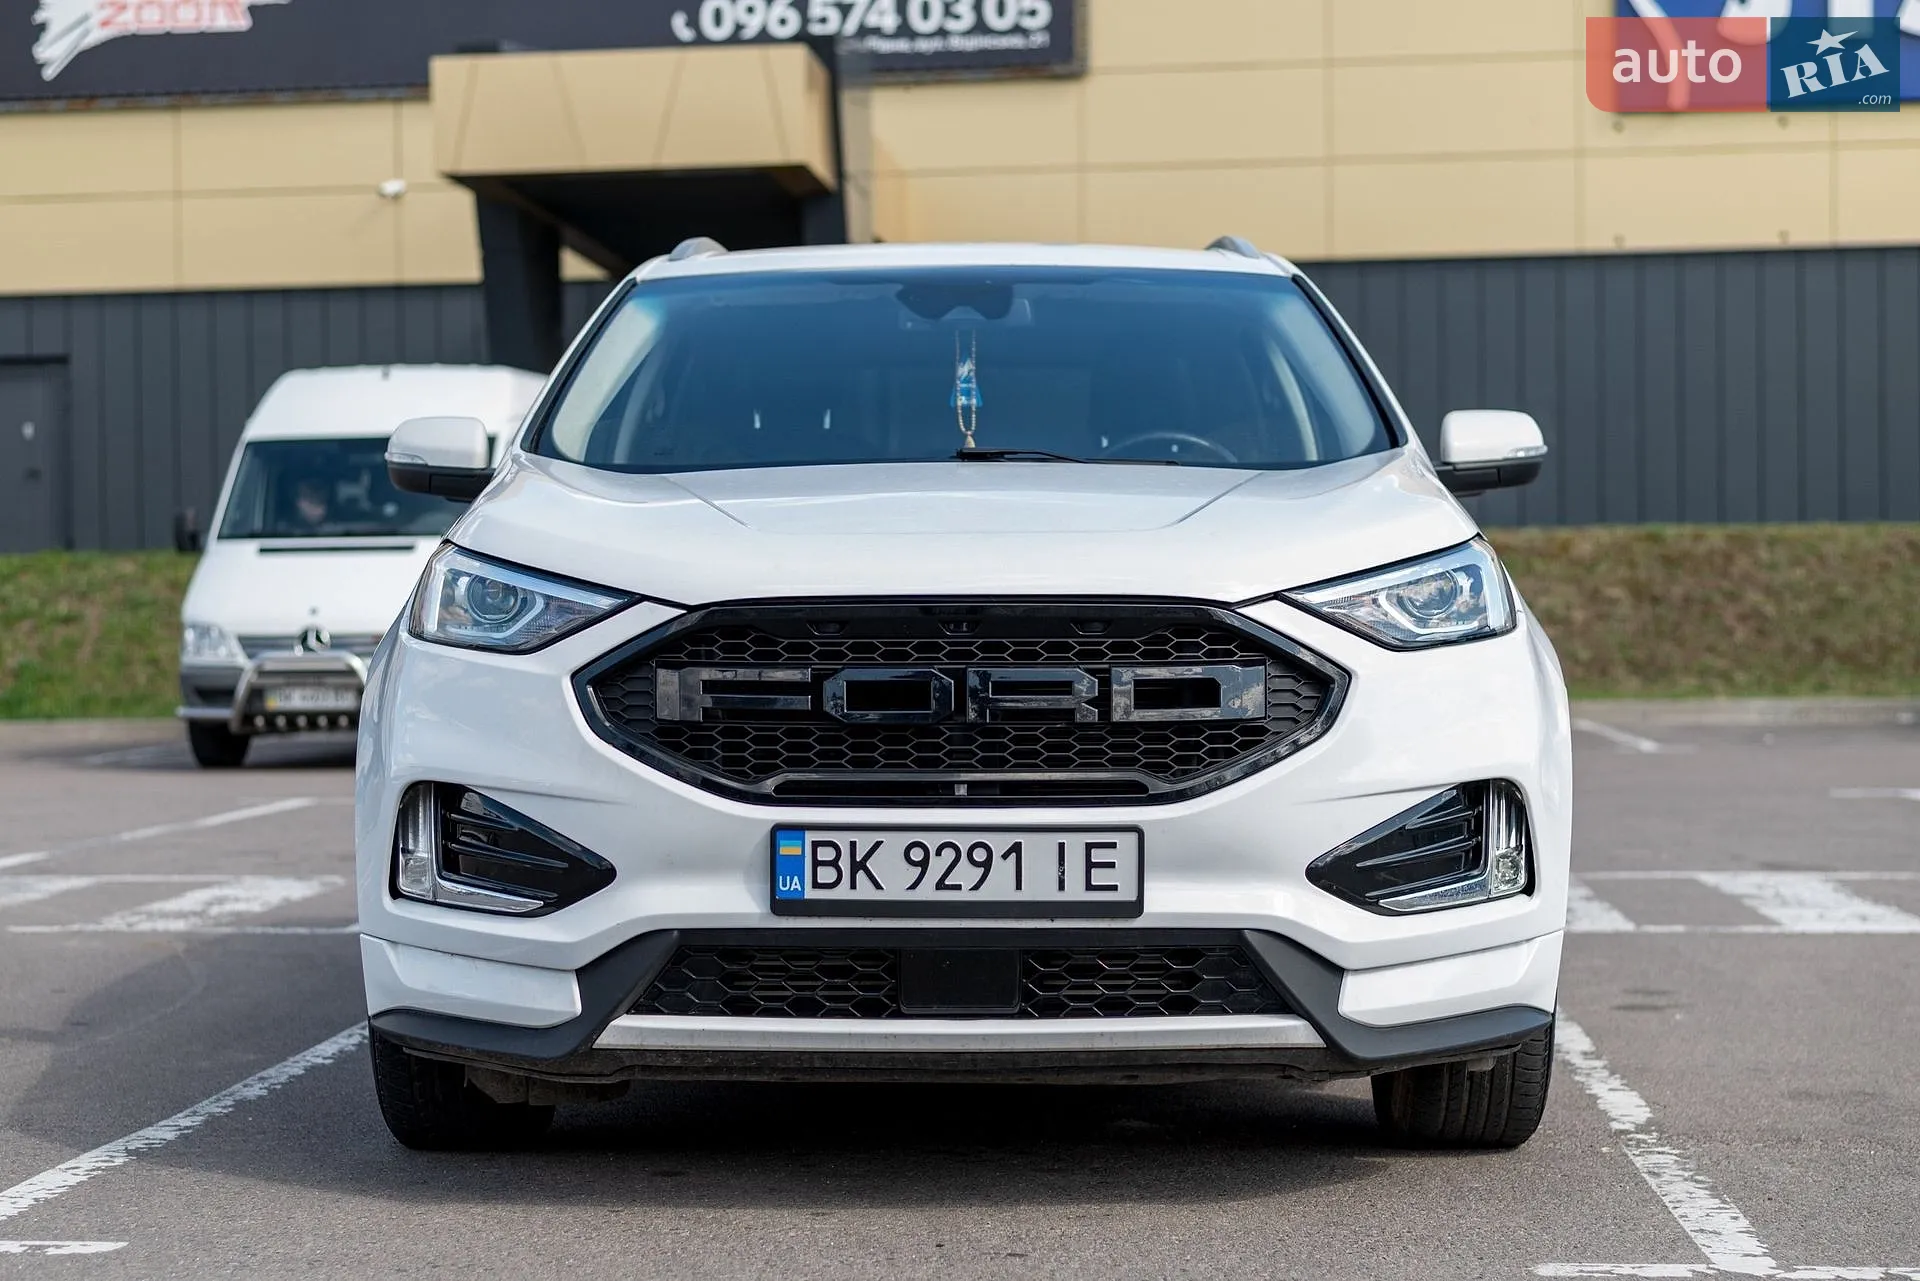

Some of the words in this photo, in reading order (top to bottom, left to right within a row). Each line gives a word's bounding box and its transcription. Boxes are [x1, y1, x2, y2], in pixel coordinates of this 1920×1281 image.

[700, 0, 801, 41] 096
[808, 0, 900, 36] 574
[906, 0, 977, 34] 03
[982, 0, 1053, 31] 05
[655, 665, 1266, 723] FORD
[779, 875, 801, 891] UA
[810, 840, 885, 891] BK
[903, 840, 1023, 891] 9291
[1057, 840, 1119, 891] IE
